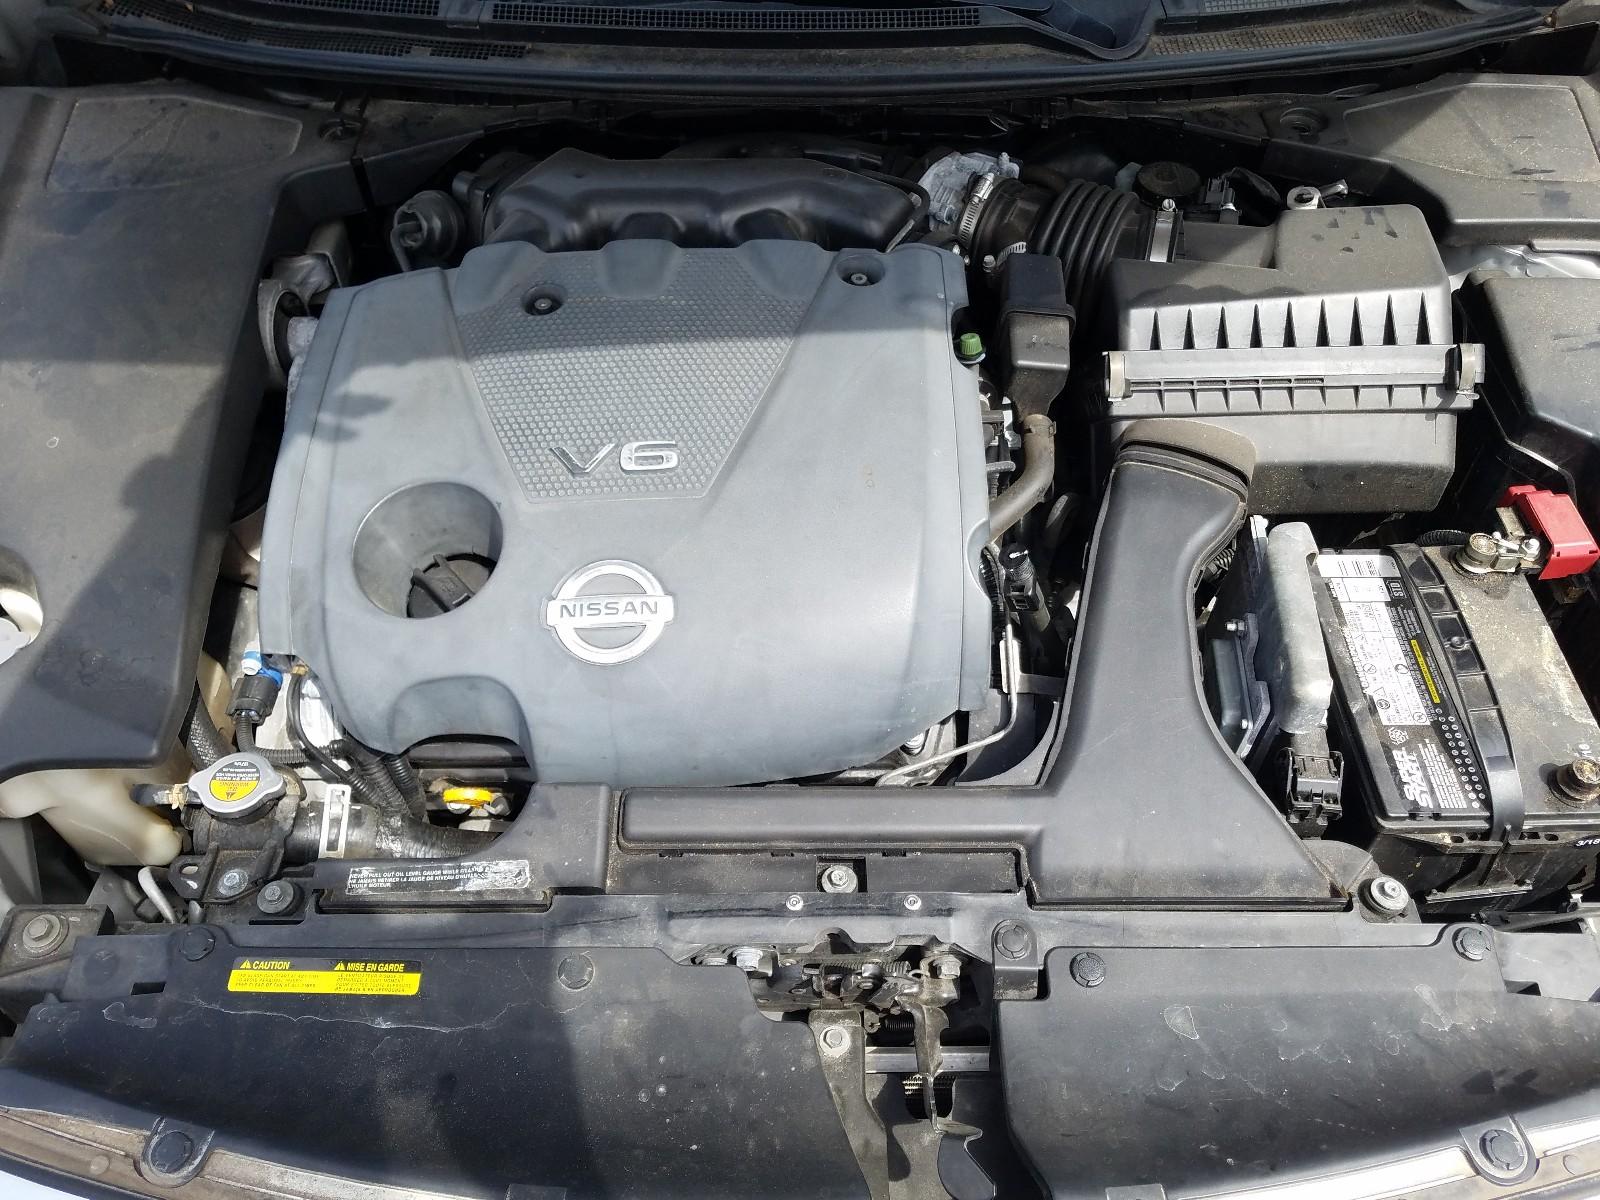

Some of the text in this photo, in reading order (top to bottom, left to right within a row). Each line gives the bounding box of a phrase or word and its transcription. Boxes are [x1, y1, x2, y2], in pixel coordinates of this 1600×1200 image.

[550, 440, 680, 477] V6
[1390, 583, 1404, 597] STD
[559, 601, 658, 618] NISSAN
[1391, 749, 1417, 800] SUPER
[1403, 752, 1433, 808] START
[252, 960, 291, 970] CAUTION
[346, 962, 405, 973] MISE EN GARDE
